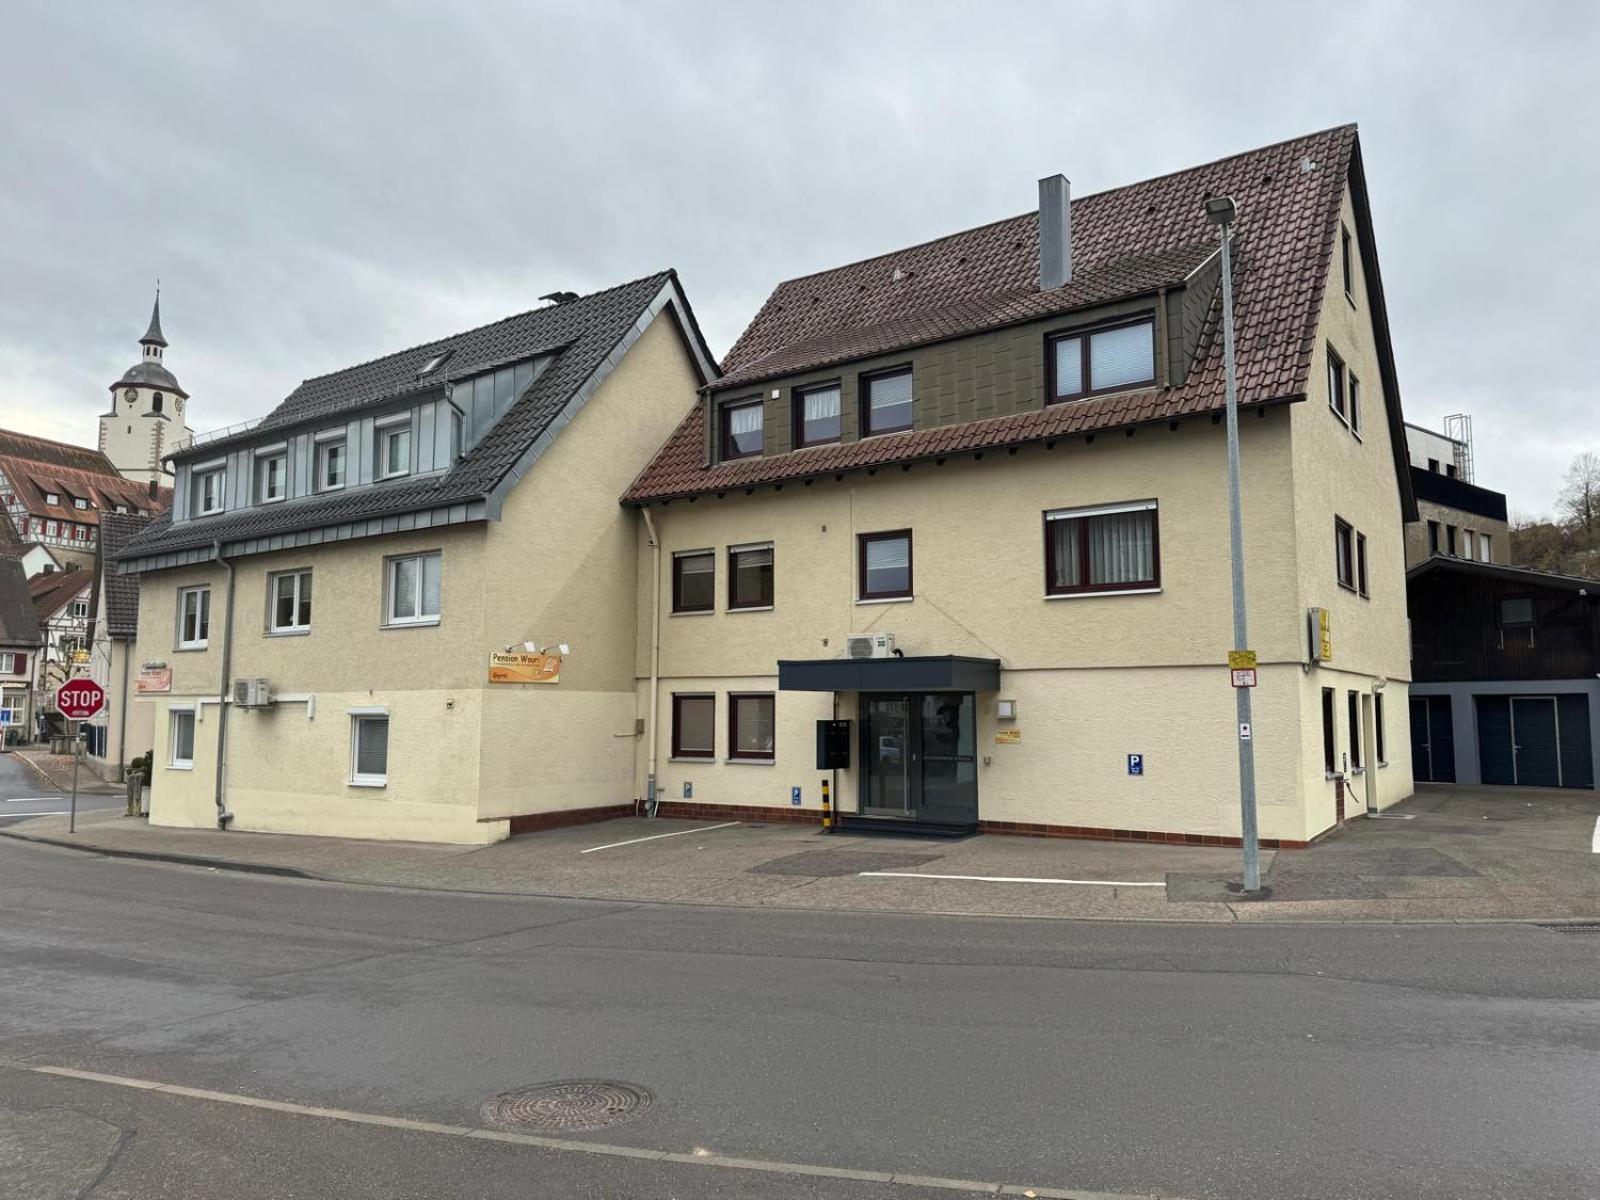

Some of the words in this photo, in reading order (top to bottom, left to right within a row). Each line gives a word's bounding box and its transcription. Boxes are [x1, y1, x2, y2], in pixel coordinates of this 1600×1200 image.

[493, 653, 518, 662] Pension
[60, 690, 101, 707] STOP
[1131, 755, 1140, 766] P
